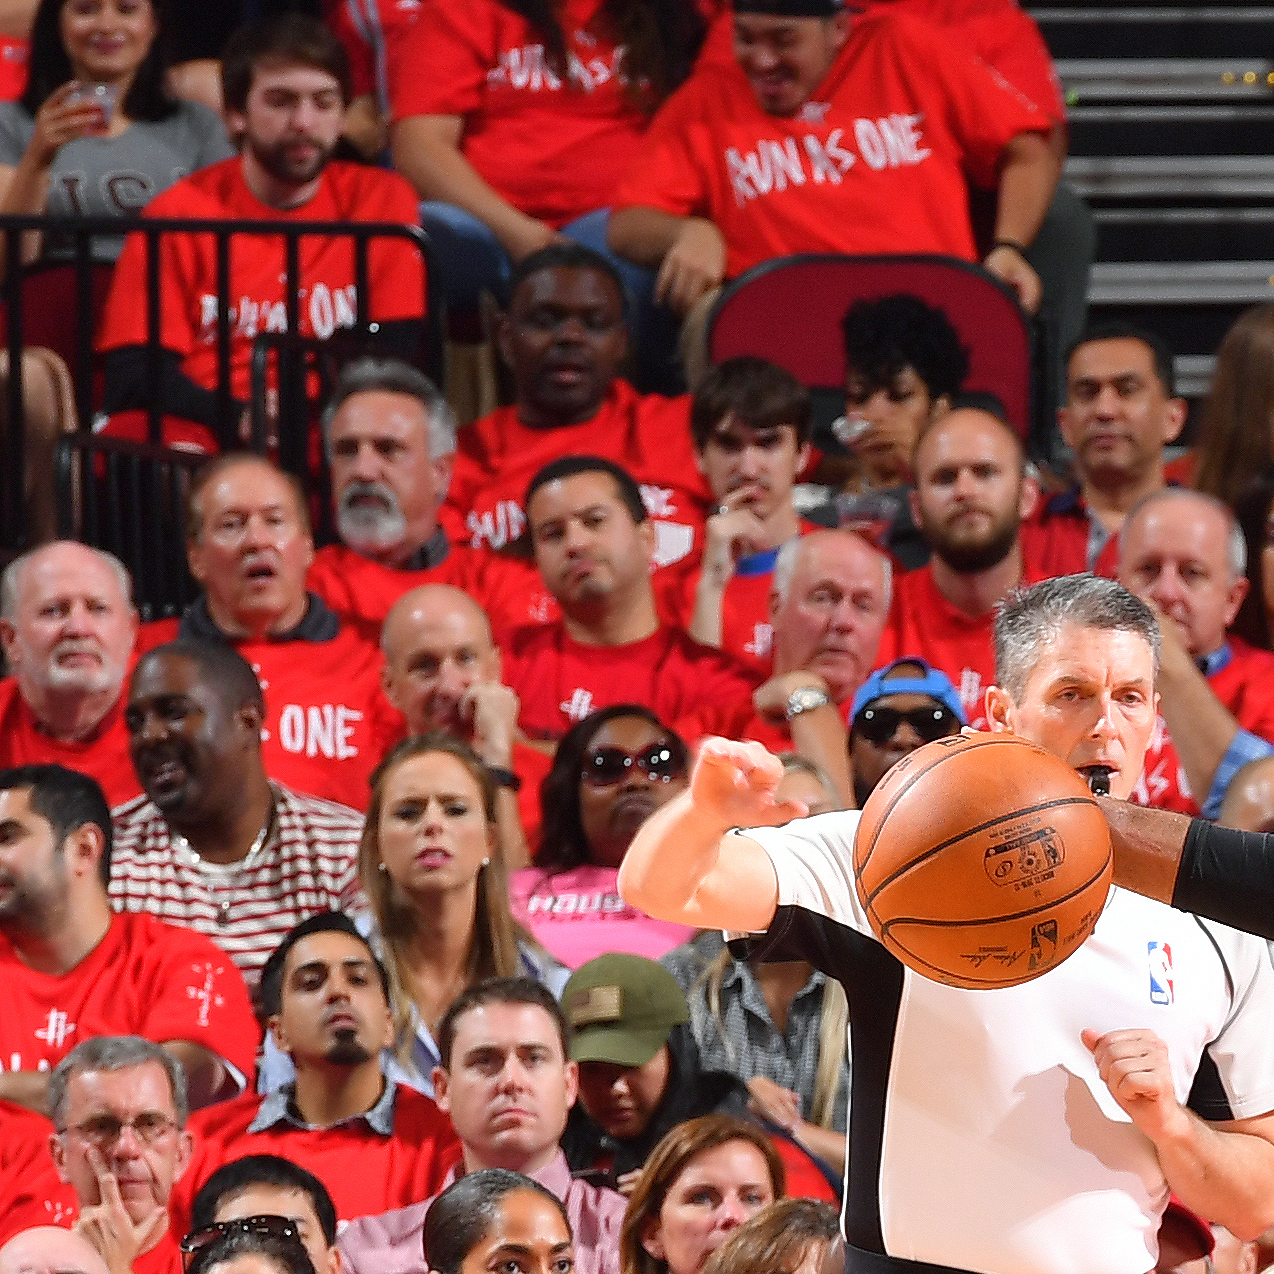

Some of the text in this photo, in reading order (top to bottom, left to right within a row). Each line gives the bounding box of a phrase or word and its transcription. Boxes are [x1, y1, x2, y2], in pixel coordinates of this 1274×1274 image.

[725, 113, 932, 208] RUN AS ONE
[279, 703, 363, 760] ONE
